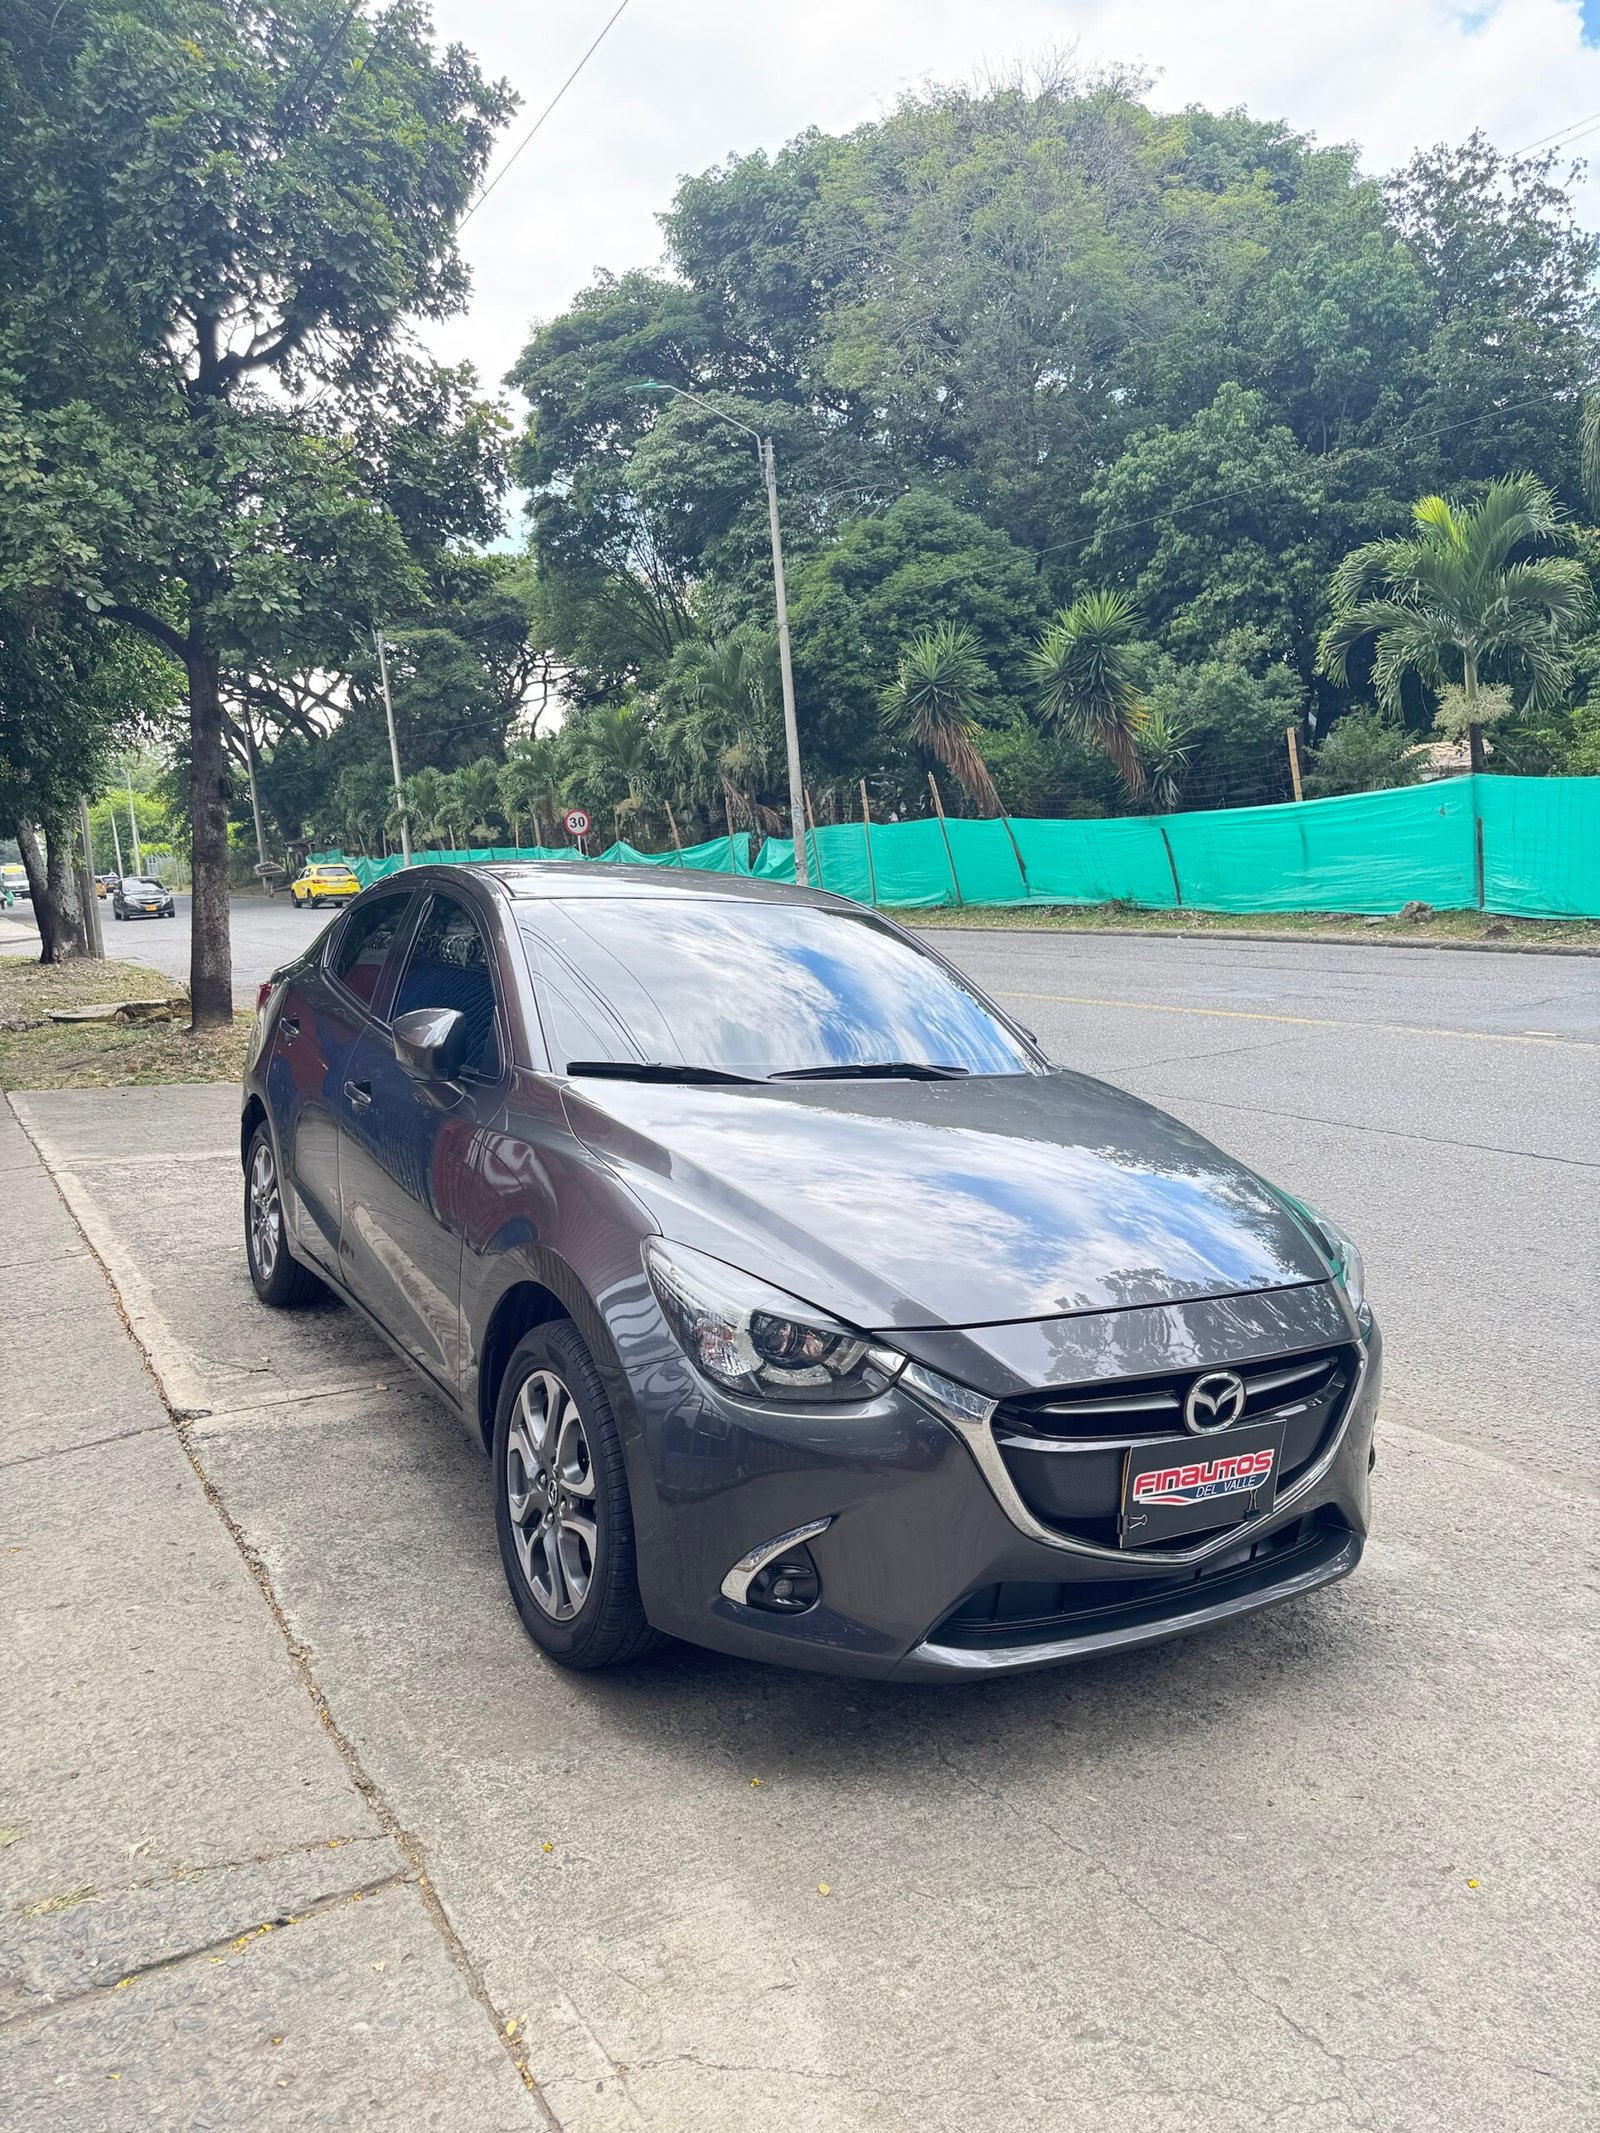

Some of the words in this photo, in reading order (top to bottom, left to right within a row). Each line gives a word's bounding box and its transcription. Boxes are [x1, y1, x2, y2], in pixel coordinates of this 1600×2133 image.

[569, 816, 585, 828] 30
[1196, 1485, 1217, 1498] DEL
[1224, 1475, 1256, 1491] VALLE
